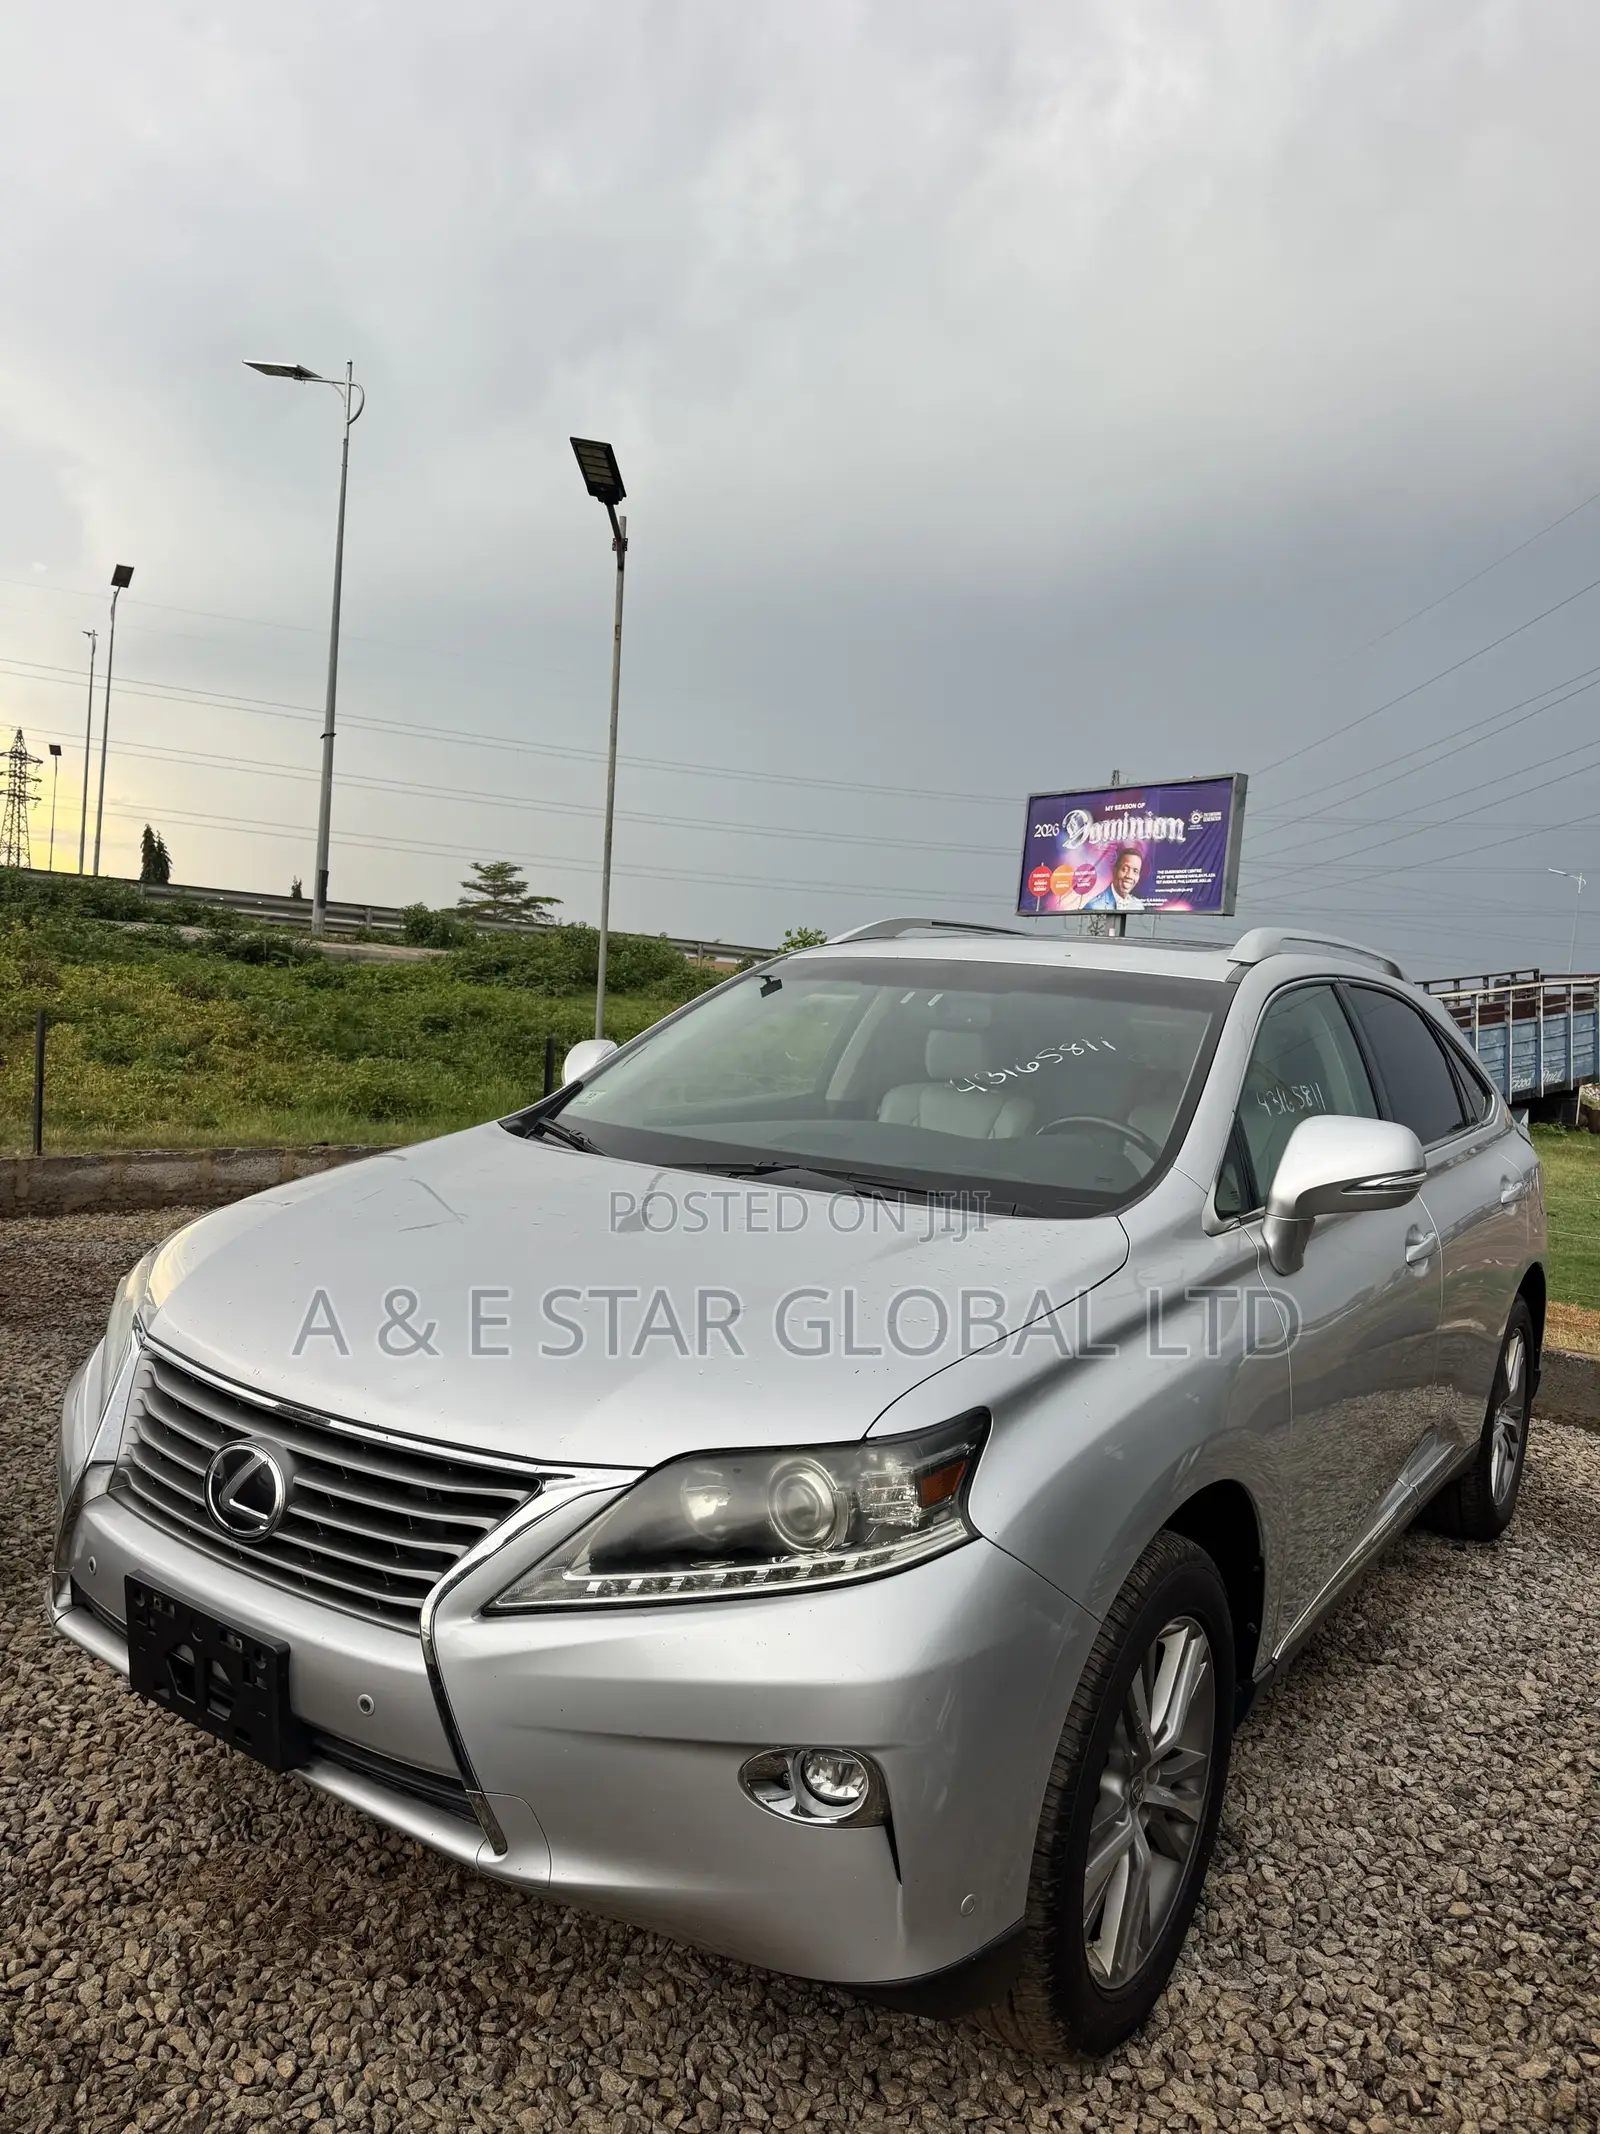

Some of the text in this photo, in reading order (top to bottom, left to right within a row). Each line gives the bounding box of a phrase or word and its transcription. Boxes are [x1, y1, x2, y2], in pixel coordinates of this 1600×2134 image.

[1114, 803, 1137, 811] SEASON
[1034, 823, 1060, 838] 2026
[1062, 809, 1186, 849] Dominion
[949, 1036, 1117, 1092] 43165811
[1256, 1082, 1326, 1117] 43165811
